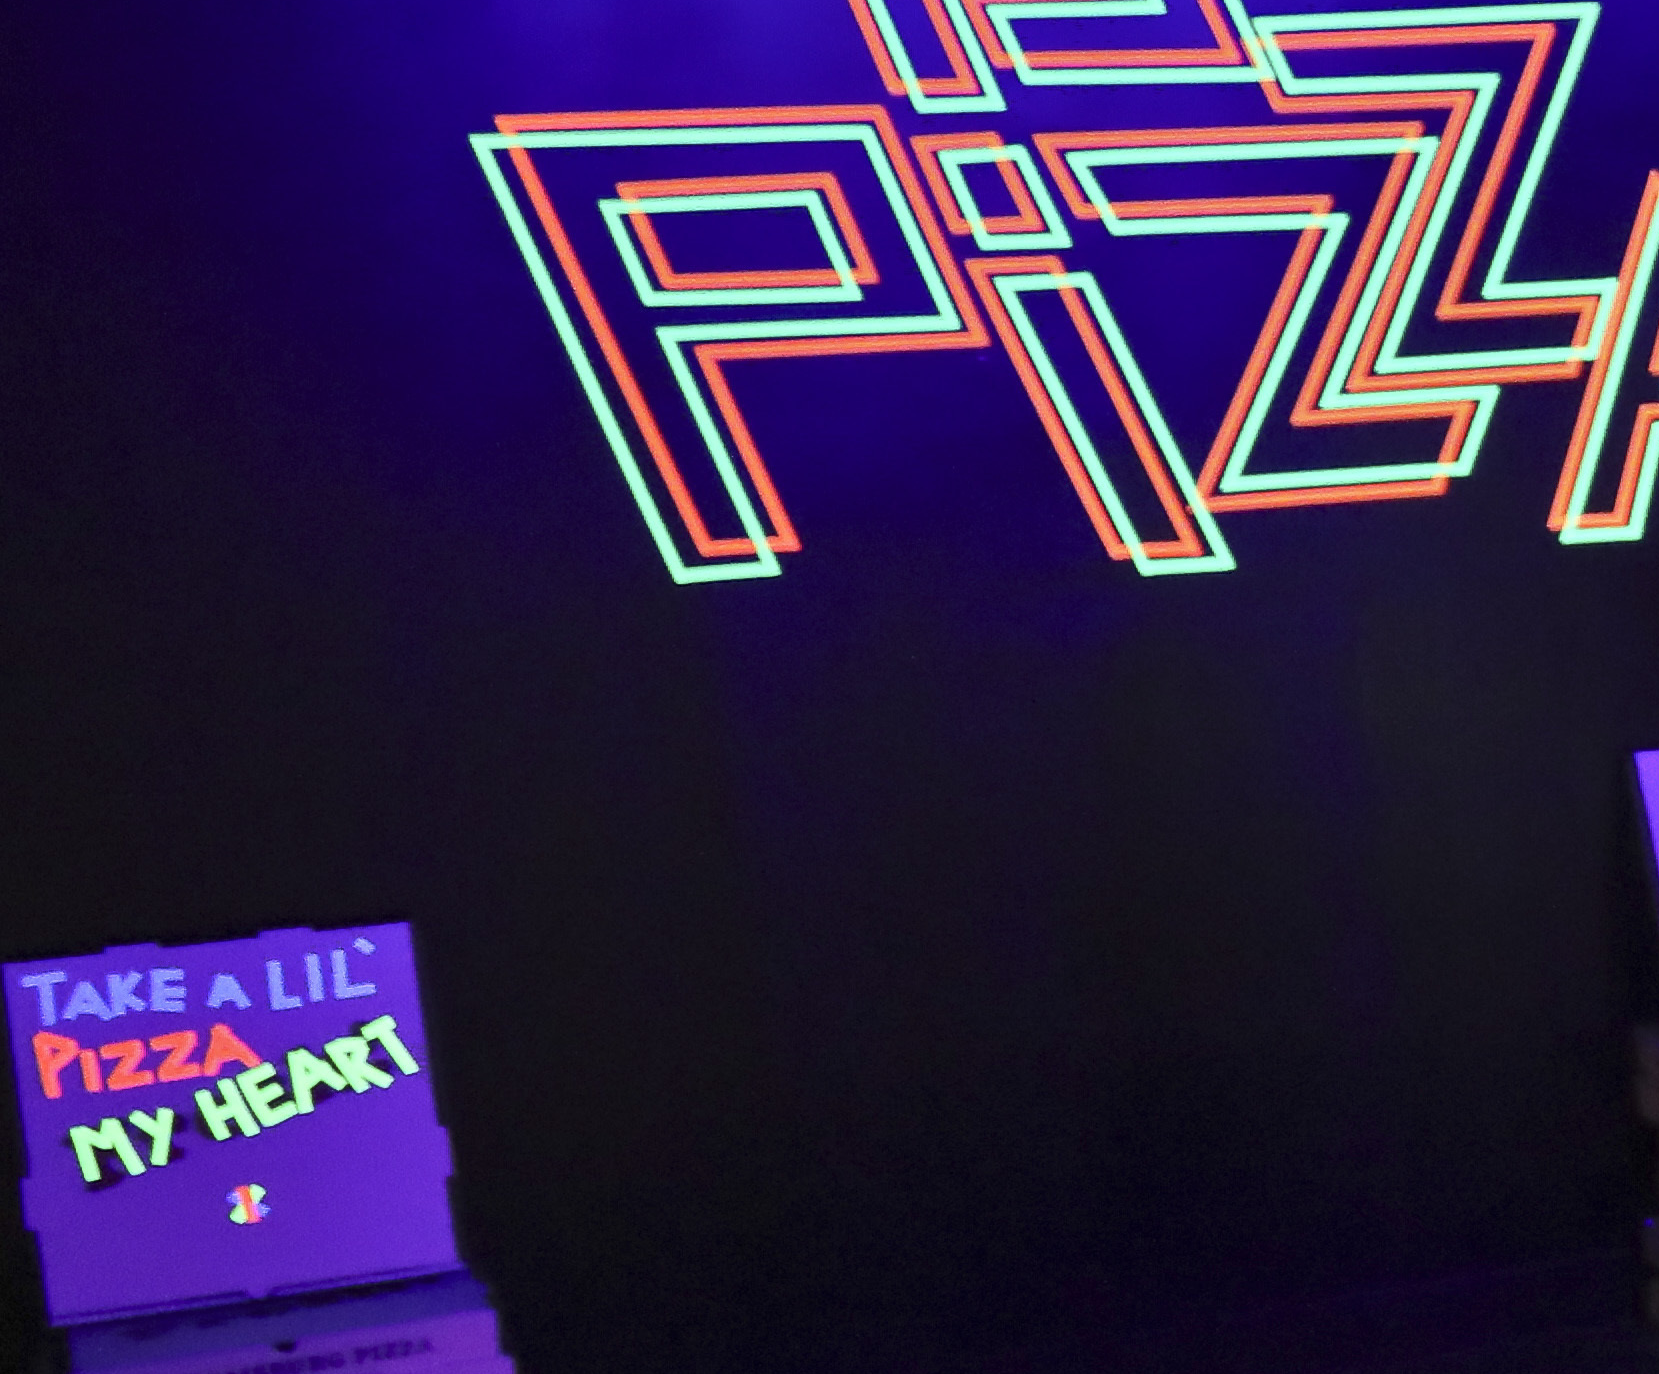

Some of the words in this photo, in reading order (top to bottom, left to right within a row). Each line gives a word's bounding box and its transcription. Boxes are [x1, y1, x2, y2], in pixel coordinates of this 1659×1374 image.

[20, 967, 187, 1026] TAKE
[207, 972, 252, 1011] A
[32, 1023, 264, 1100] PIZZA
[69, 1106, 175, 1183] MY
[194, 1014, 420, 1142] HEART
[354, 1339, 433, 1365] PIZZA
